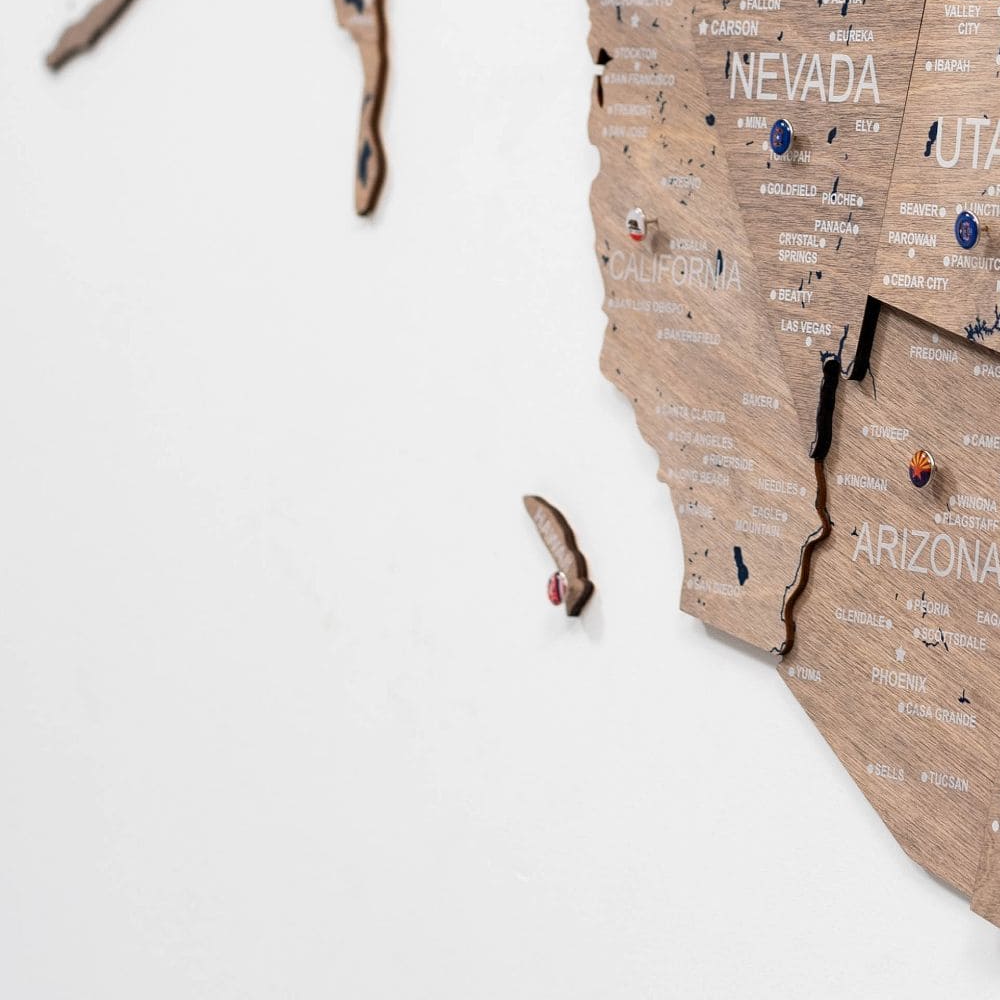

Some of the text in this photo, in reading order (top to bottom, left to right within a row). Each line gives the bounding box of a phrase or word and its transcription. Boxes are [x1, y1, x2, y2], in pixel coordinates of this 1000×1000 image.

[944, 5, 981, 18] VALLEY
[711, 20, 758, 36] CARSON
[837, 30, 874, 42] EUREKA
[958, 22, 980, 35] CITY
[934, 60, 970, 72] IBAPAH
[729, 51, 881, 104] NEVADA
[855, 119, 874, 133] ELY
[768, 183, 817, 197] GOLDFIELD
[822, 192, 856, 206] PIOCHE
[900, 204, 938, 217] BEAVER
[815, 220, 852, 235] PANACA
[778, 232, 819, 248] CRYSTAL
[889, 231, 937, 247] PAROWAN
[778, 250, 817, 264] SPRINGS
[608, 250, 742, 291] CALIFORNIA
[891, 274, 949, 290] CEDAR CITY
[778, 289, 813, 303] BEATTY
[781, 319, 831, 336] LAS VEGAS
[910, 346, 958, 363] FREDONIA
[742, 393, 774, 409] BAKER
[759, 478, 799, 496] NEEDLES
[844, 475, 888, 491] KINGMAN
[942, 513, 999, 531] FLAGSTAFF
[835, 607, 886, 628] GLENDALE
[920, 628, 987, 651] SCOTTSDALE
[872, 667, 928, 692] PHOENIX
[906, 703, 977, 728] CASA GRANDE
[930, 770, 969, 792] TUCSAN
